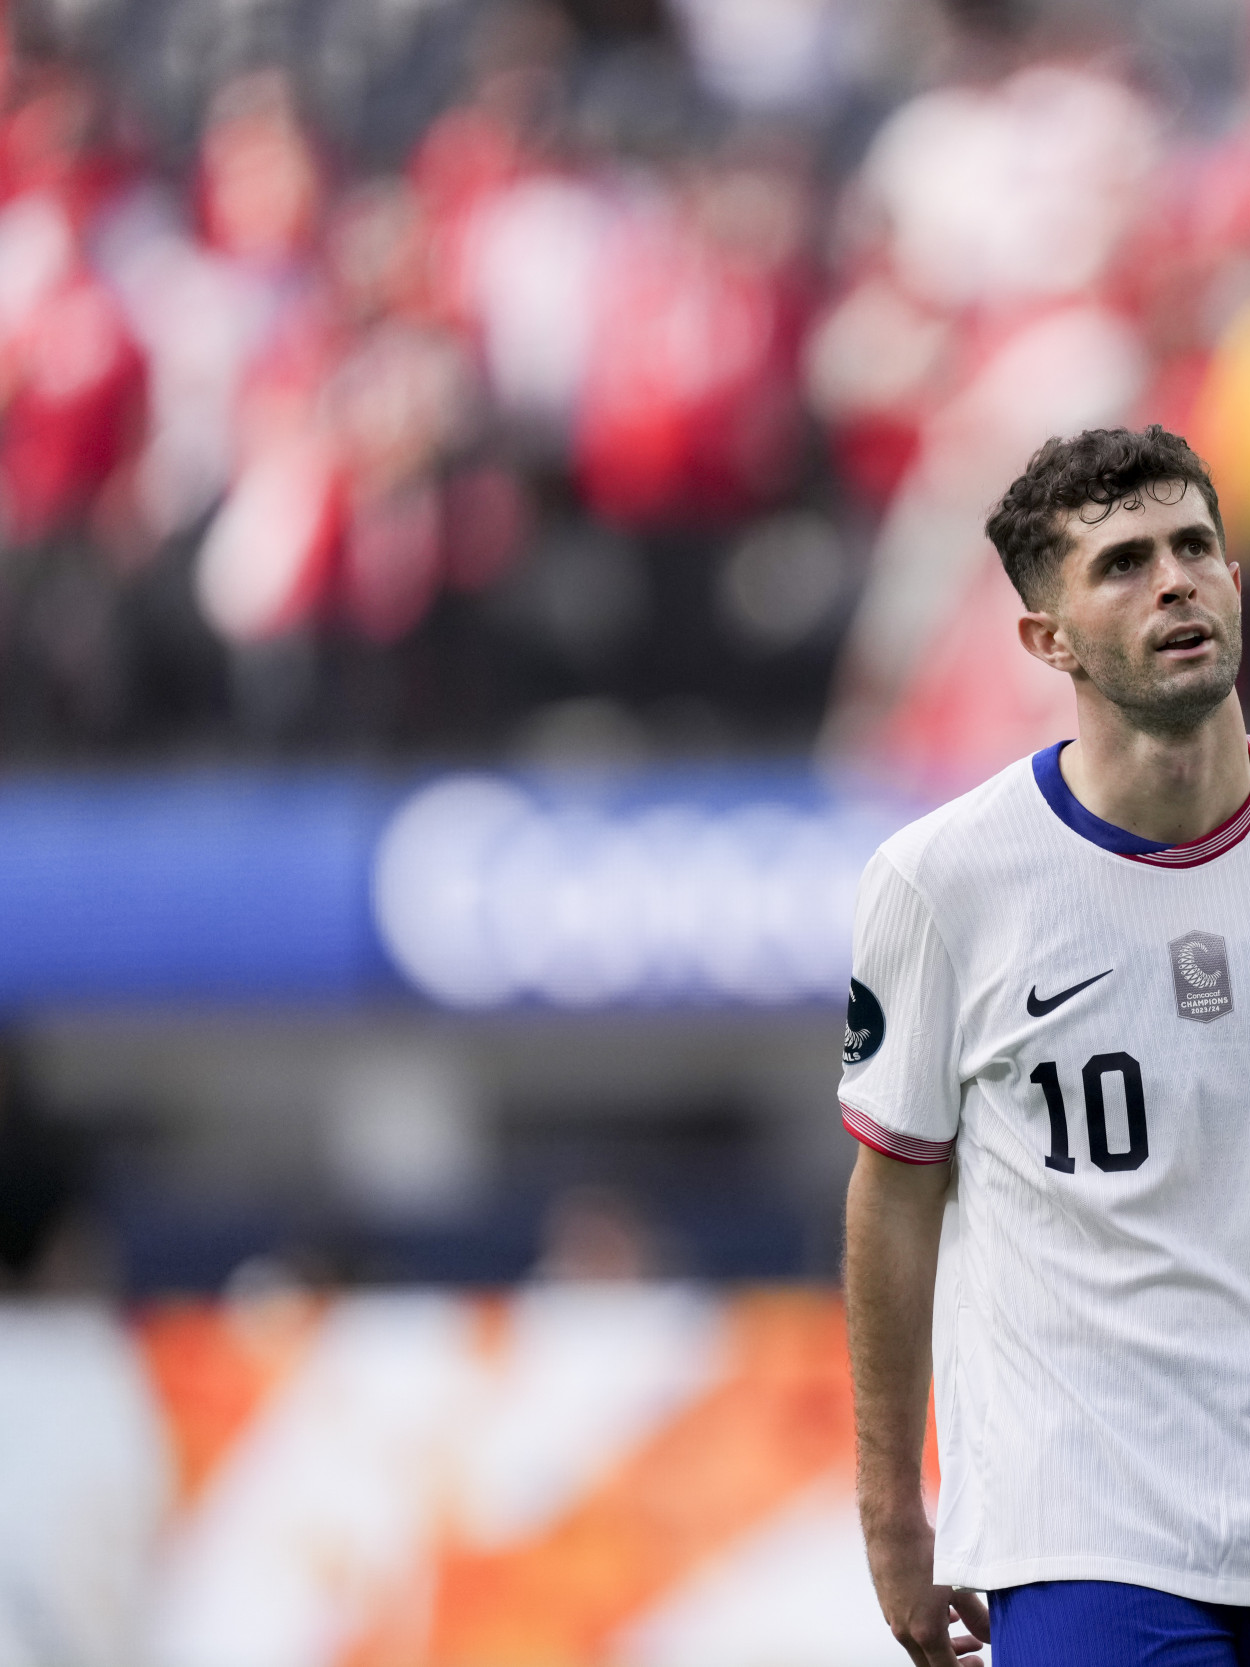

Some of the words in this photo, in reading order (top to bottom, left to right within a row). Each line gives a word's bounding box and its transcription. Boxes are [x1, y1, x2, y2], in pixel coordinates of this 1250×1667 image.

[1186, 990, 1220, 999] Concacaf
[1181, 997, 1228, 1008] CHAMPIONS
[1191, 1006, 1220, 1014] 2023/24
[842, 1051, 861, 1061] ALS
[1030, 1051, 1149, 1174] 10
